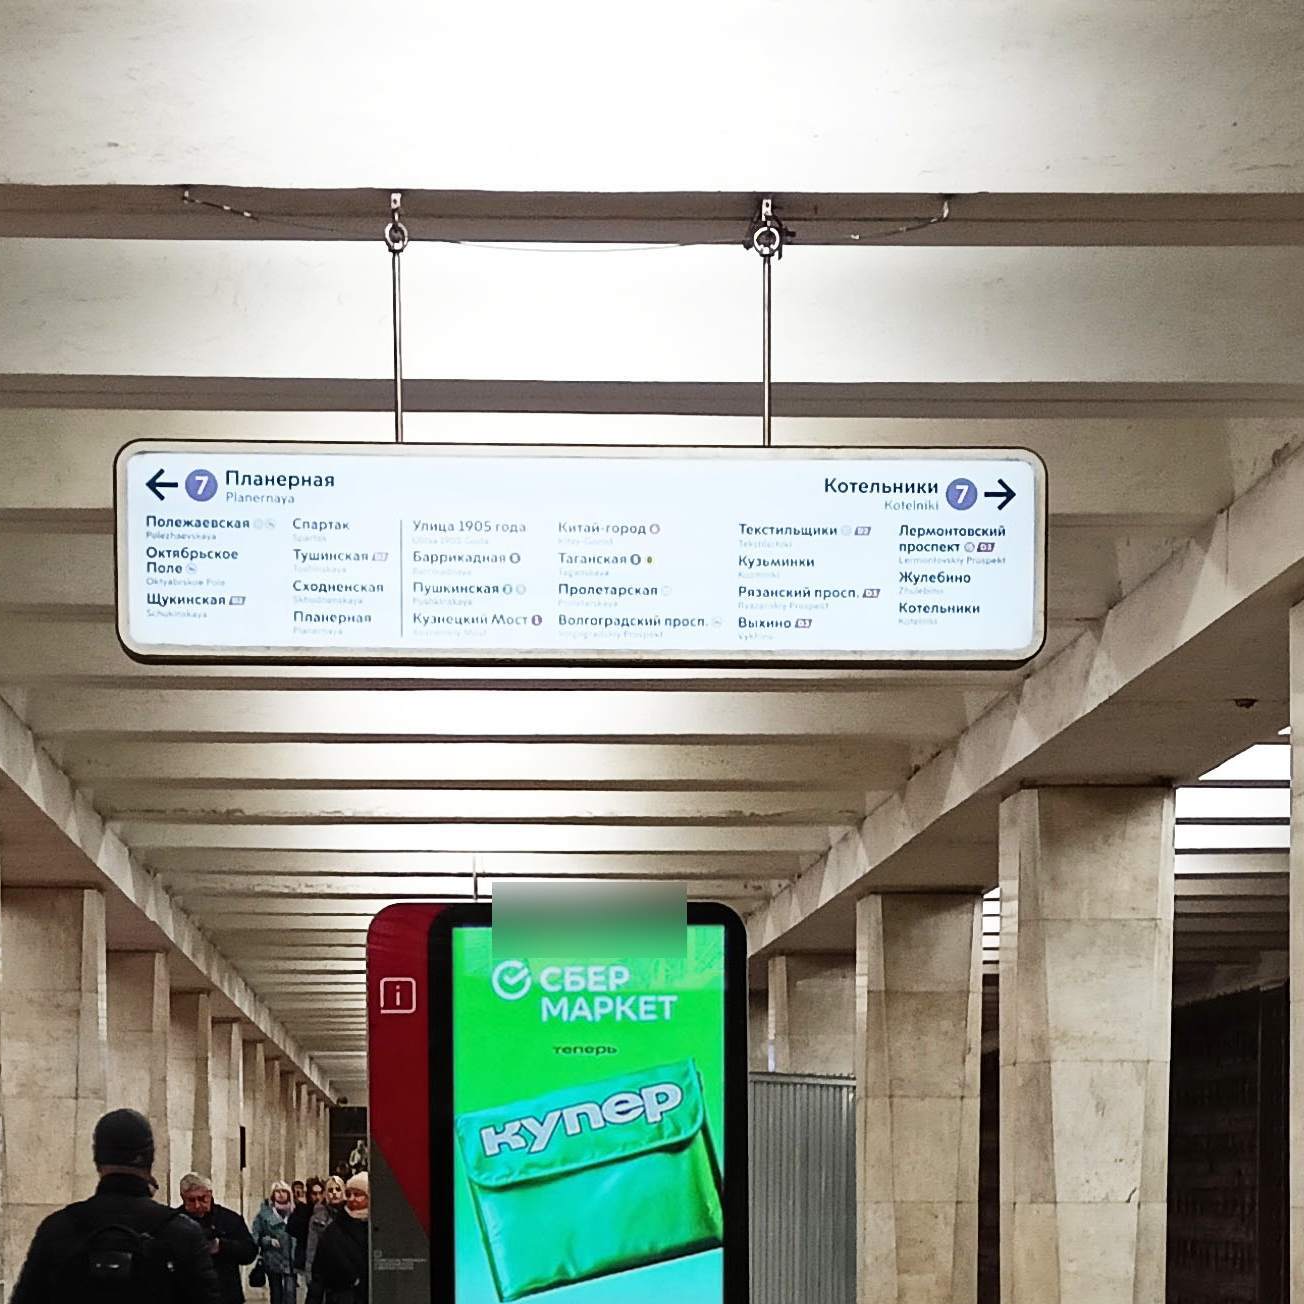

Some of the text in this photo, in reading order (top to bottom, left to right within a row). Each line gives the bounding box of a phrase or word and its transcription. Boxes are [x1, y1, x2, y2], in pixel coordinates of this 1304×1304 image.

[194, 469, 335, 496] 7 Планерная
[225, 491, 295, 504] Planernaya
[824, 477, 970, 504] Котельники 7
[884, 500, 939, 511] Kotelniki
[145, 515, 251, 529] Полежаевская
[292, 518, 350, 531] Спартак
[412, 519, 527, 533] Улица 1905 года
[558, 521, 647, 536] Китай-город
[738, 523, 838, 537] Текстильщики
[898, 524, 1006, 539] Лермонтовский
[145, 547, 239, 561] Октябрьское
[899, 542, 961, 554] проспект
[292, 549, 369, 563] Тушинская
[412, 551, 507, 565] Баррикадная
[558, 552, 627, 564] Таганская
[738, 555, 815, 569] Кузьминки
[146, 561, 183, 574] Поле
[898, 571, 972, 585] Жулебино
[292, 579, 384, 594] Сходненская
[412, 581, 500, 595] Пушкинская
[558, 583, 658, 597] Пролетарская
[738, 586, 811, 598] Рязанский
[146, 592, 227, 607] Щукинская
[898, 602, 981, 614] Котельники
[292, 611, 372, 625] Планерная
[412, 612, 528, 626] Кузнецкий Мост
[558, 614, 661, 628] Волгоградский
[738, 616, 792, 629] Выхино
[539, 965, 631, 992] СБЕР
[540, 995, 678, 1023] МАРКЕТ
[552, 1045, 618, 1056] теперь
[479, 1081, 685, 1158] купер
